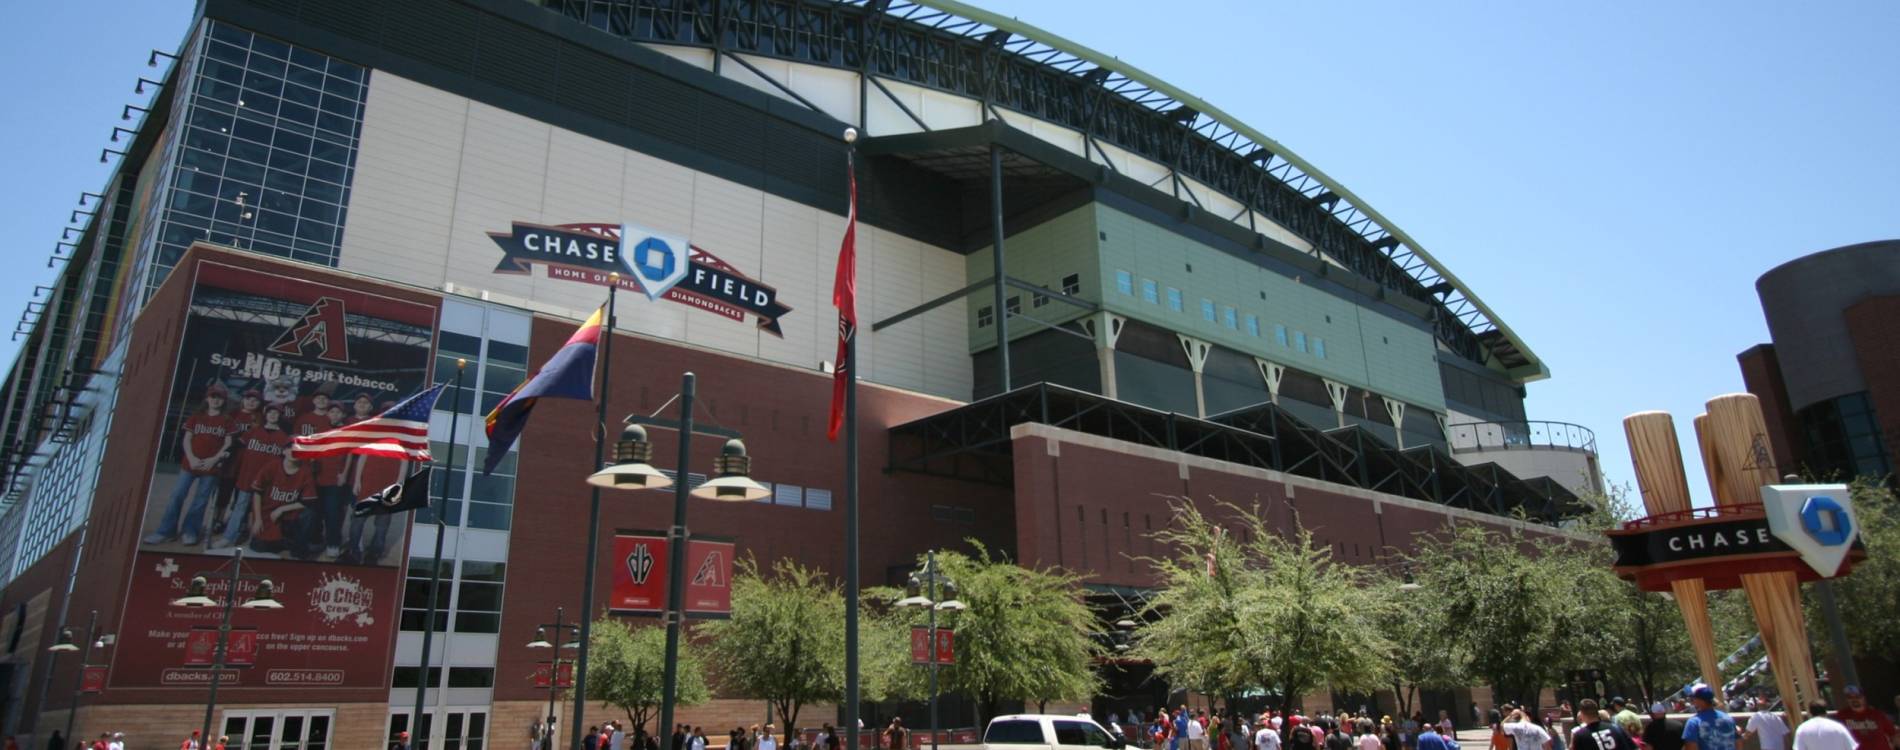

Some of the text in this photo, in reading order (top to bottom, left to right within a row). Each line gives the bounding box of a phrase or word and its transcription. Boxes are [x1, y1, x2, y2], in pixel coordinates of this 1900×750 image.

[524, 233, 769, 307] CHASE FIELD
[555, 268, 586, 279] HOME
[594, 274, 607, 283] OF
[671, 291, 741, 318] DIAMONDBACKS
[210, 351, 399, 392] Say NO to spit tobacco.
[1668, 528, 1769, 552] CHASE
[310, 586, 374, 610] No Chew
[325, 604, 350, 613] Crew
[148, 630, 171, 638] Make
[172, 631, 190, 641] your
[289, 633, 306, 642] Sign
[307, 634, 317, 643] up
[328, 634, 369, 642] dbacks.com
[276, 642, 289, 650] the
[290, 643, 311, 652] upper
[165, 671, 236, 681] dbacks.om
[269, 671, 341, 682] 602.514.8400
[1591, 729, 1616, 750] 15
